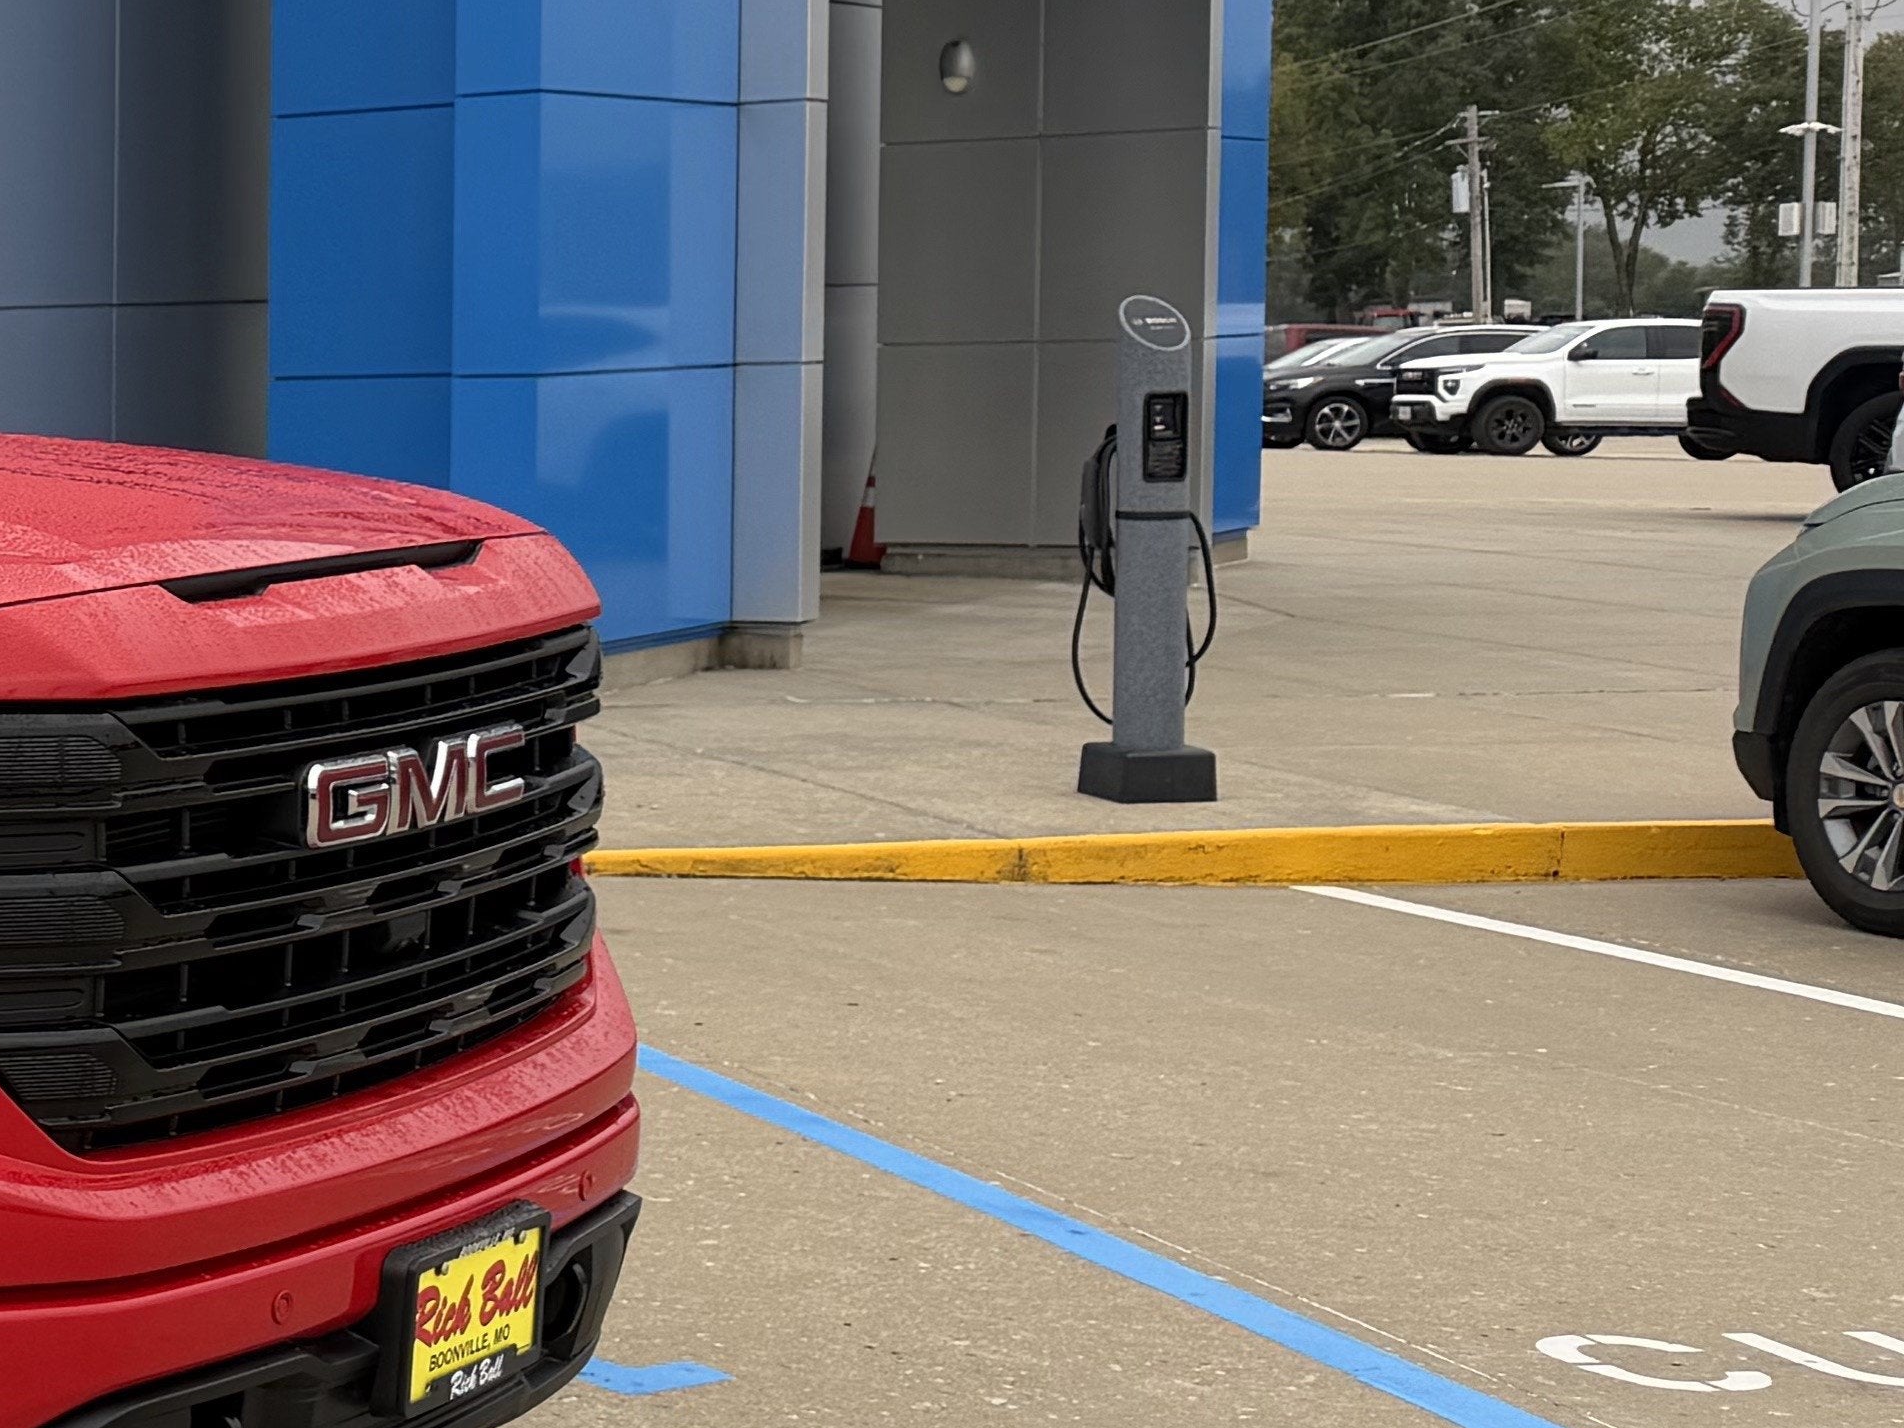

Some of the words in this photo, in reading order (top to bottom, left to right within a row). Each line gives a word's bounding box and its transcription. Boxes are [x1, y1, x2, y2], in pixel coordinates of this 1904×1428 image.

[306, 724, 525, 849] GMC
[415, 1274, 475, 1347] Rick
[479, 1251, 539, 1326] Ball
[429, 1332, 491, 1372] BOONVILLE,
[493, 1324, 511, 1348] MO
[450, 1362, 477, 1400] Rick
[479, 1354, 505, 1386] Ball
